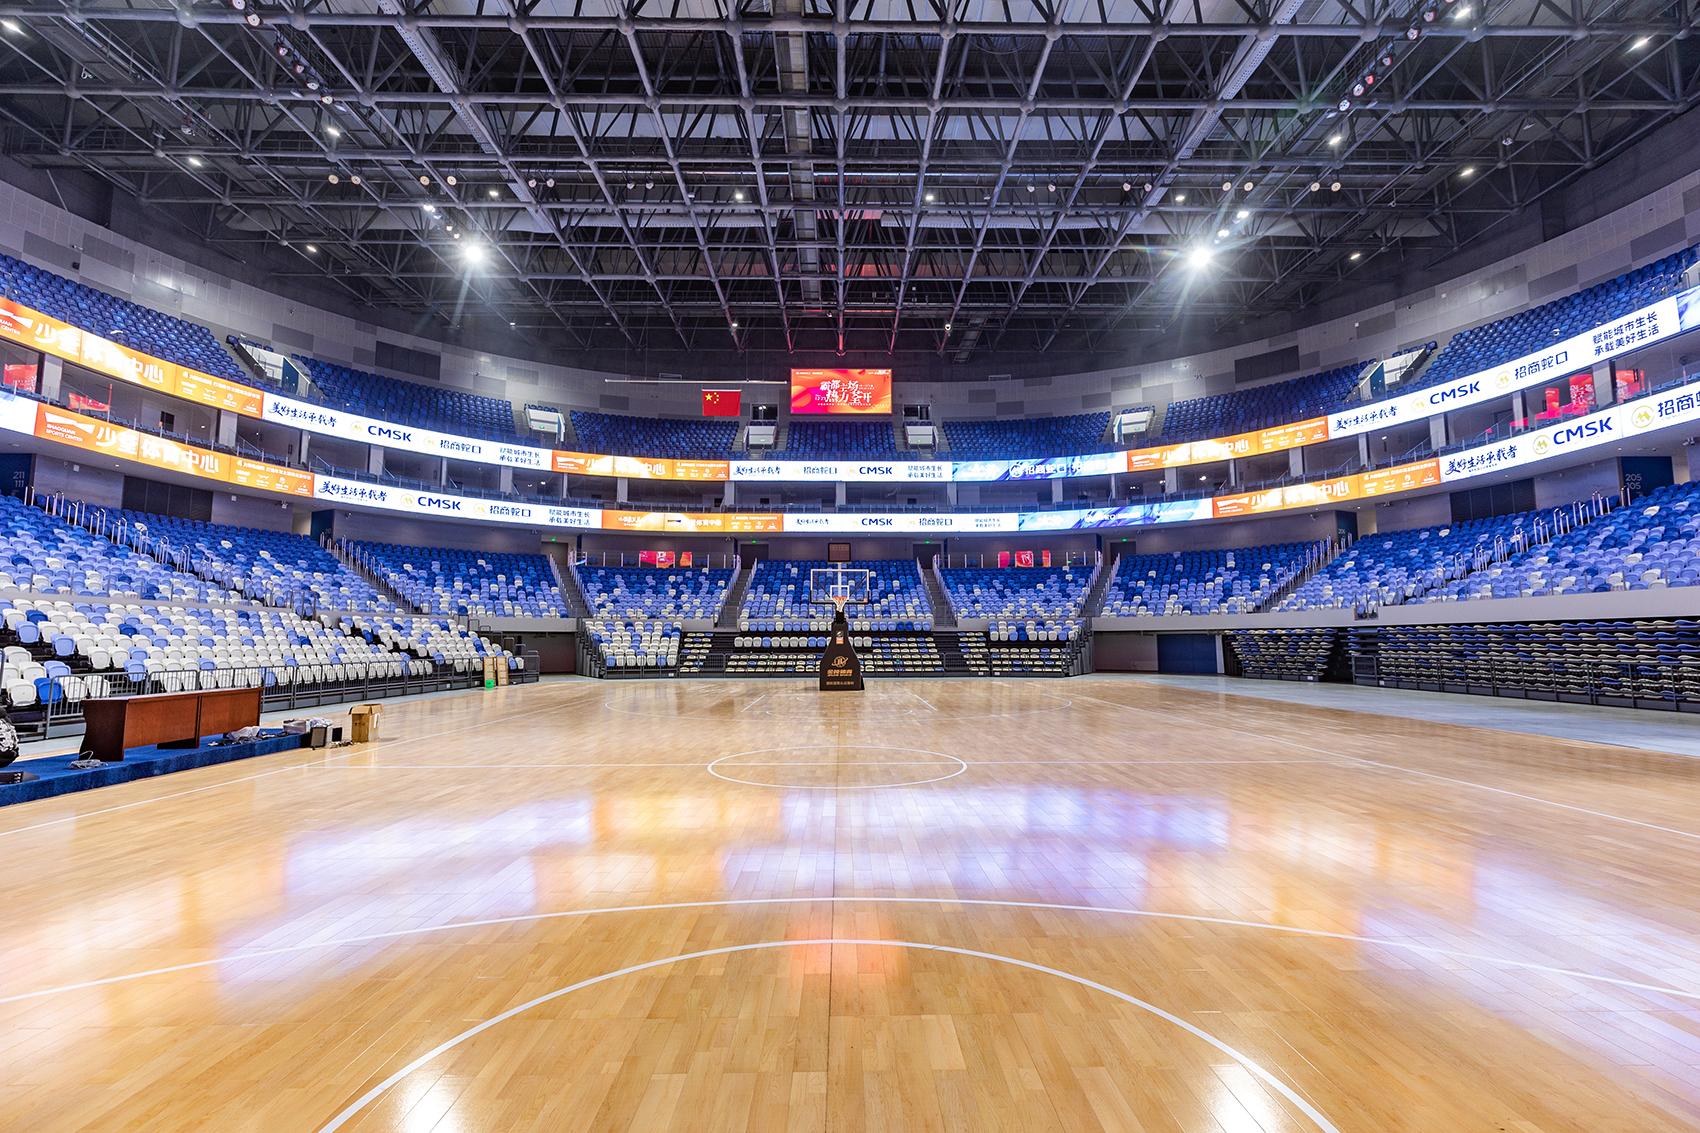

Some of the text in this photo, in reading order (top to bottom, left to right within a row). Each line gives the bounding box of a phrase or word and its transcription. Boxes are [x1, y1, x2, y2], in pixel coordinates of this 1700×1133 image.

[1592, 311, 1657, 345] 赋能城市生长
[1594, 323, 1660, 356] 承载美好生活
[1514, 350, 1568, 380] 招商蛇口
[1430, 380, 1481, 405] CMSK
[268, 402, 337, 427] 美好生活承载者
[1333, 405, 1398, 431] 美好生活承载者
[46, 429, 83, 442] SPORTS CENTER
[368, 425, 412, 442] CMSK
[1553, 416, 1613, 445] CMSK
[95, 426, 219, 474] 少荃体育中心
[440, 439, 482, 454] 招商蛇口
[1445, 445, 1517, 475] 美好生活承载者
[12, 471, 25, 479] 211
[803, 466, 838, 475] 招商蛇口
[859, 466, 893, 475] CMSK
[1025, 464, 1066, 475] 招商蛇口
[14, 480, 25, 488] 111
[1625, 473, 1642, 482] 205
[318, 481, 387, 501] 美好生活承载者
[1626, 482, 1641, 490] 105
[417, 496, 461, 511] CMSK
[489, 505, 531, 518] 招商蛇口
[861, 518, 893, 526] CMSK
[919, 518, 953, 526] 招商蛇口
